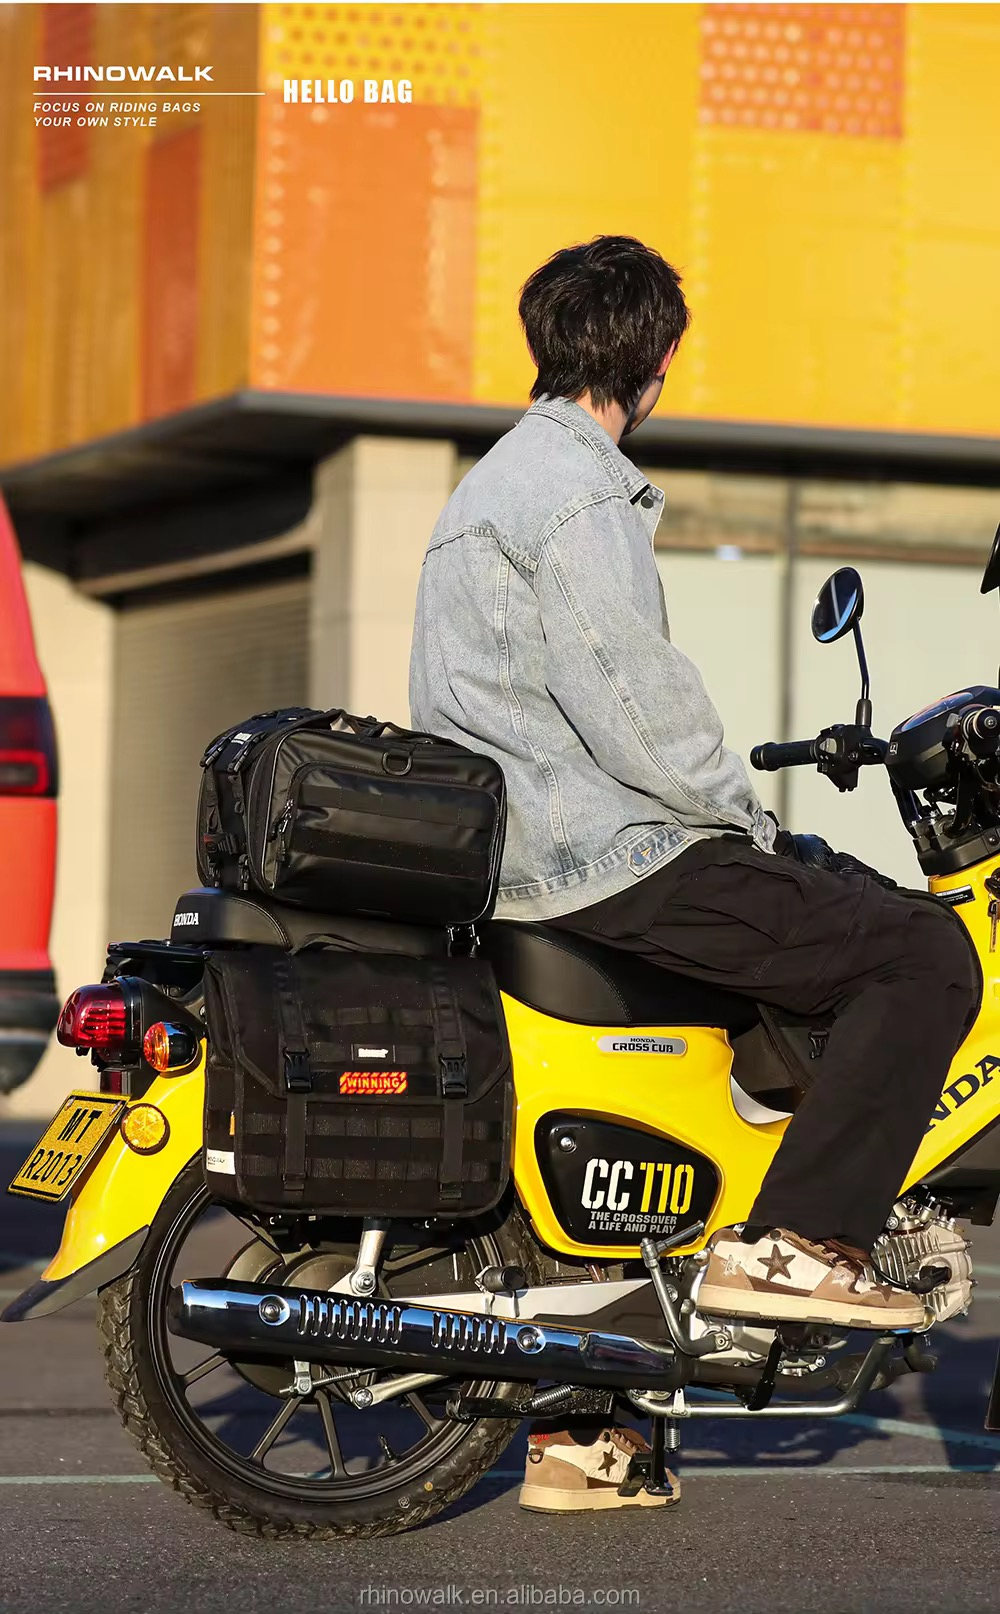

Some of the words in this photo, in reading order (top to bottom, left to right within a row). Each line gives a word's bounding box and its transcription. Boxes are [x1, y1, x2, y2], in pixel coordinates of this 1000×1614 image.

[173, 912, 200, 927] HONDA
[612, 1042, 649, 1052] CROSS
[651, 1043, 674, 1053] CUB
[347, 1077, 400, 1089] WINNING
[57, 1107, 103, 1143] MT
[21, 1148, 83, 1187] R2013
[590, 1211, 610, 1221] THE
[613, 1213, 677, 1225] CROSSOVER
[588, 1221, 596, 1230] A
[599, 1222, 621, 1231] LIFE
[624, 1223, 647, 1233] AND
[649, 1224, 676, 1234] PLAY
